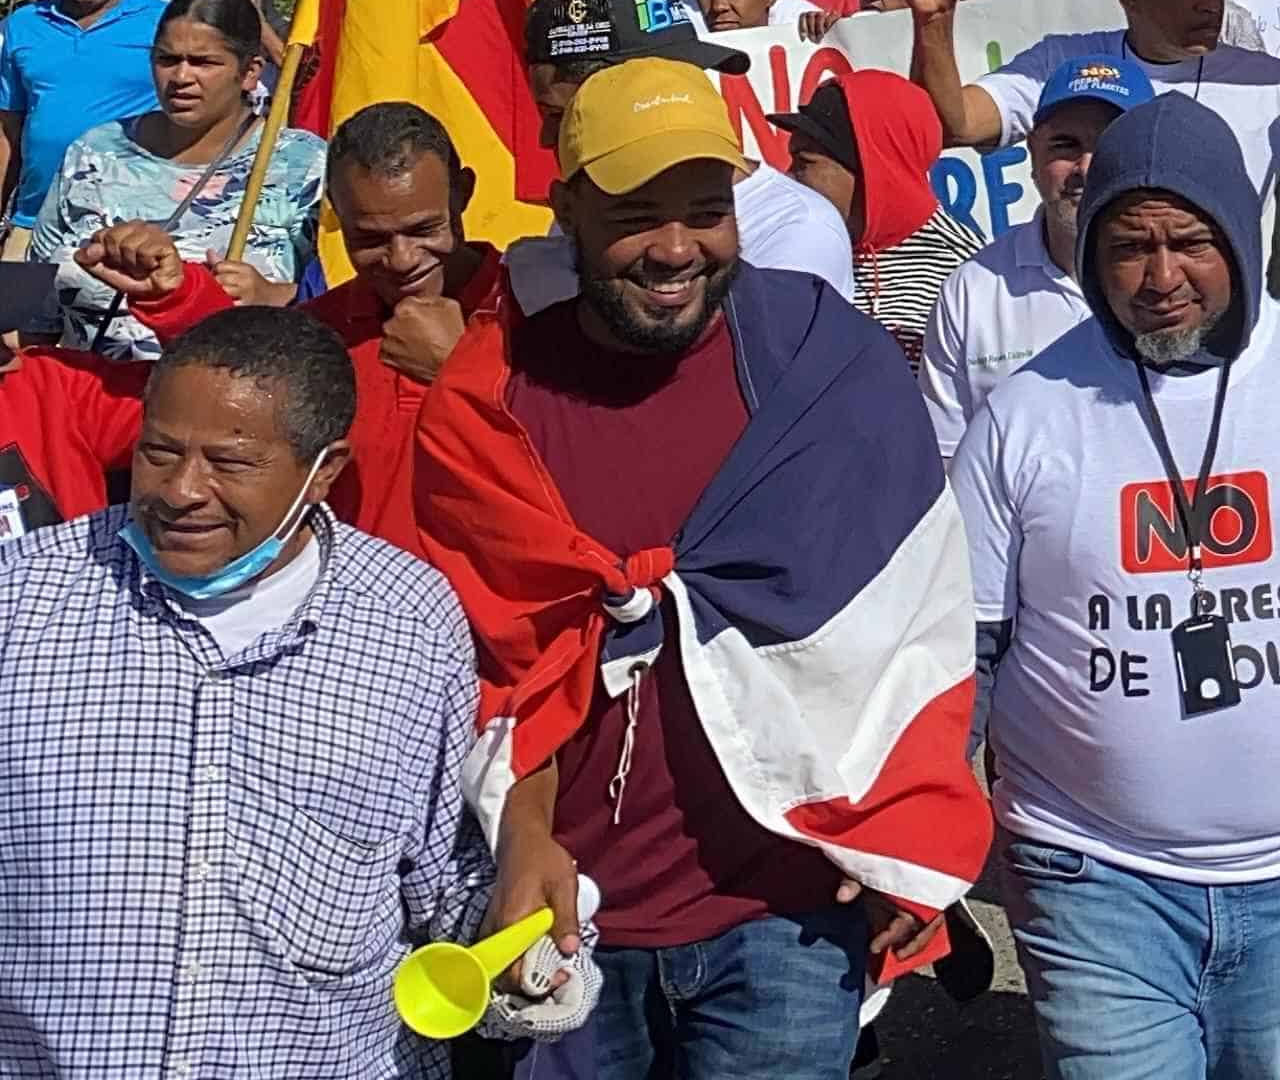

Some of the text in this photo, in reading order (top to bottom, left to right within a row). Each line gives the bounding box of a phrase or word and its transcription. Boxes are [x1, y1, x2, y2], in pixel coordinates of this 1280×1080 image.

[1135, 482, 1260, 565] NO
[1088, 594, 1110, 631] A
[1126, 593, 1173, 631] LA
[1089, 647, 1150, 697] DE
